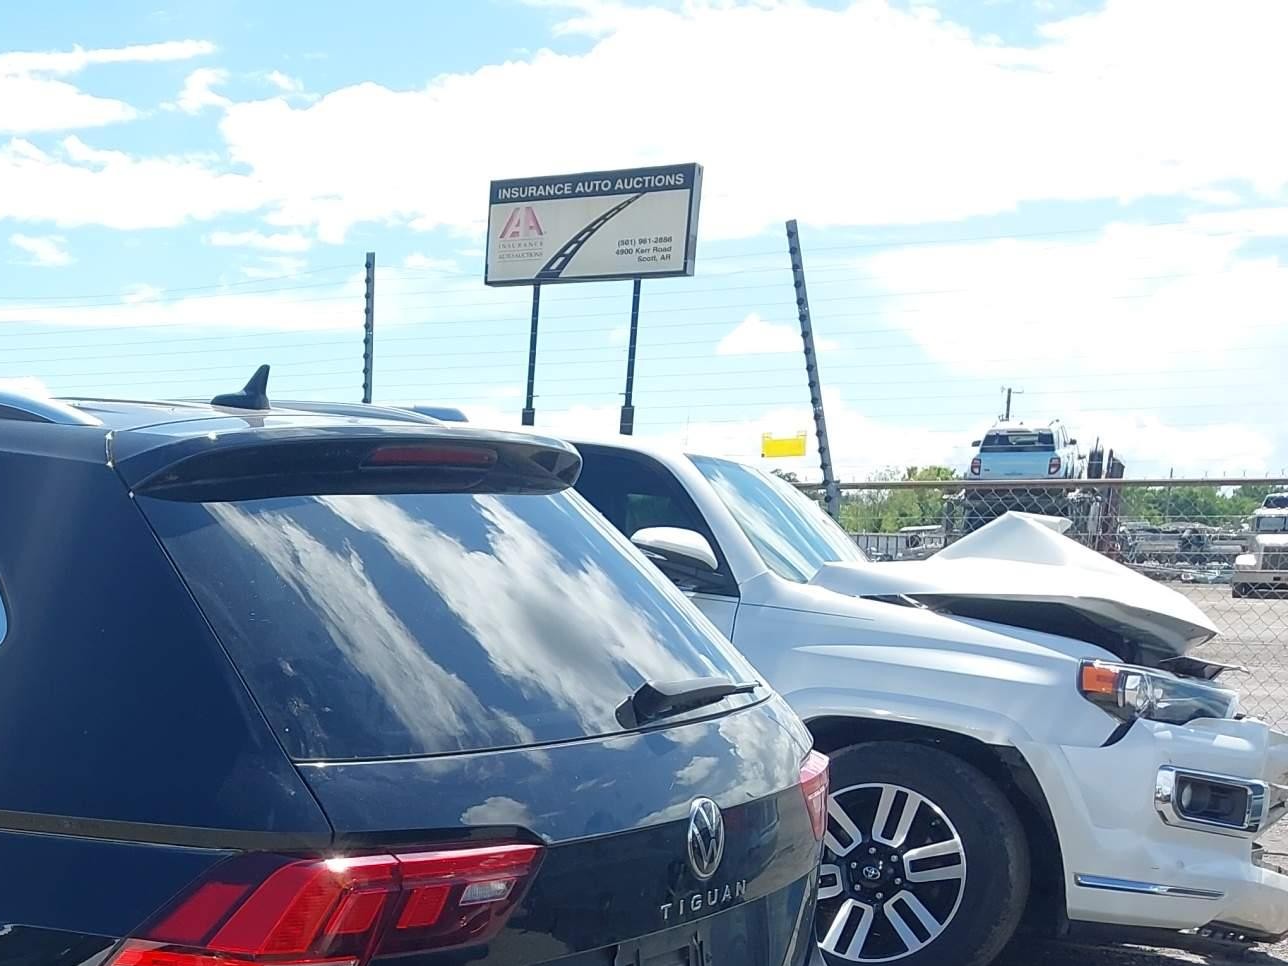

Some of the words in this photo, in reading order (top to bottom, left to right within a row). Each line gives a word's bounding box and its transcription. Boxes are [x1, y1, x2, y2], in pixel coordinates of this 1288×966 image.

[498, 182, 573, 200] INSURANCE
[575, 178, 612, 193] AUTO
[614, 173, 685, 190] AUCTIONS
[616, 248, 634, 256] 4900
[652, 245, 673, 253] Road
[660, 253, 672, 261] AR
[660, 879, 747, 920] TIGUAN
